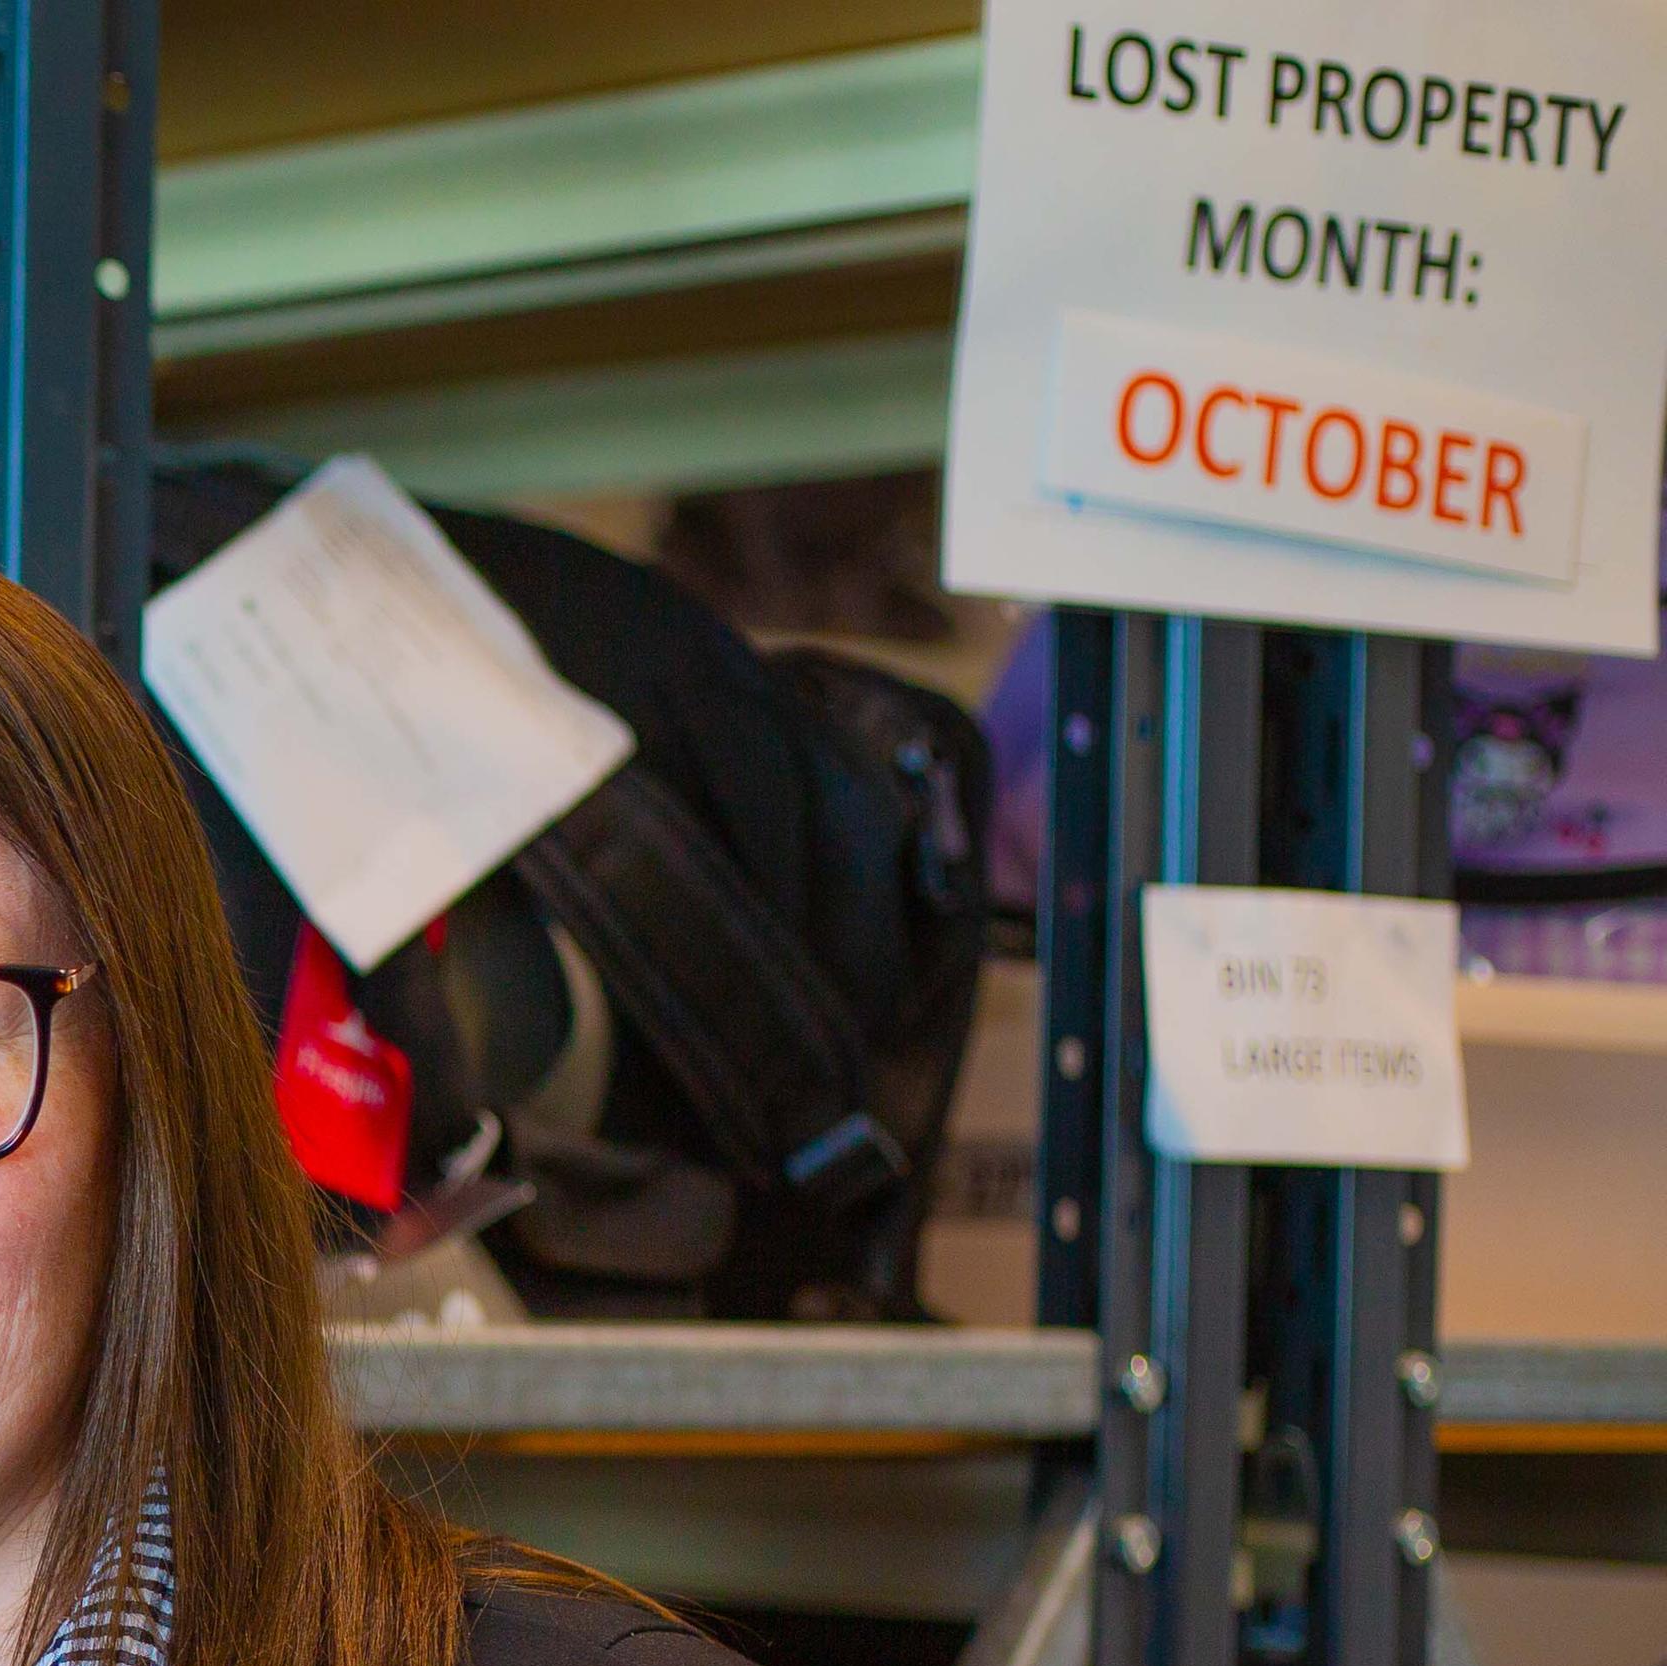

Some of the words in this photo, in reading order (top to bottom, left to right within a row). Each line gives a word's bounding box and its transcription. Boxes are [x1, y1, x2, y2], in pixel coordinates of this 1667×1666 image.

[1067, 24, 1246, 119] LOST
[1267, 54, 1626, 174] PROPERTY
[1186, 197, 1484, 306] MONTH:
[1115, 370, 1527, 537] OCTOBER
[1220, 957, 1283, 998] BIN
[1223, 1037, 1325, 1079] LARGE
